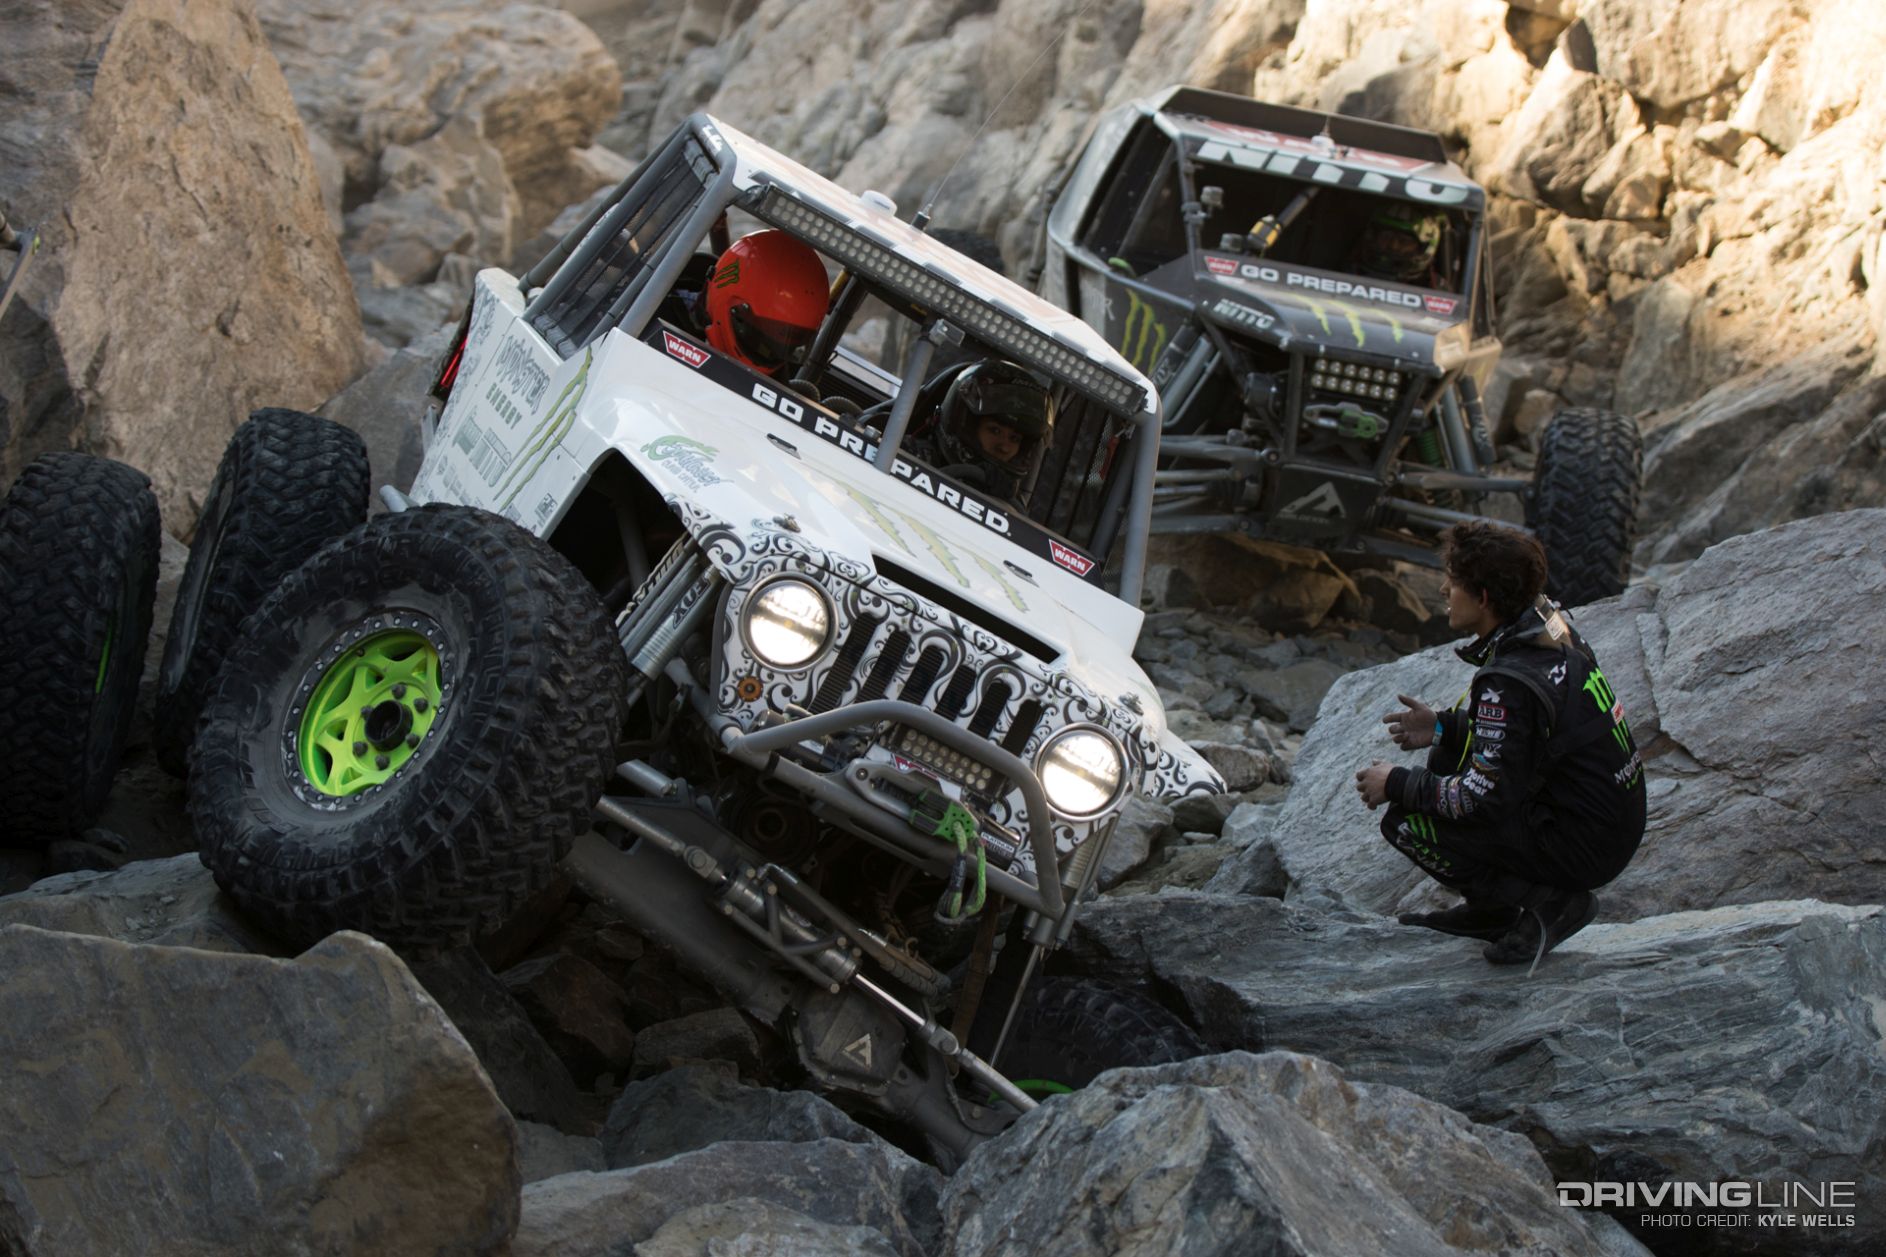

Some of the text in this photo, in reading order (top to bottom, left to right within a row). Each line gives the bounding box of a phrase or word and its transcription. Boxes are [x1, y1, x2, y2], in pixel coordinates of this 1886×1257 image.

[1241, 263, 1421, 308] GO PREPARED
[668, 339, 702, 363] WARN
[751, 382, 804, 423] GO
[1053, 547, 1086, 571] WARN
[672, 577, 711, 630] FOX
[1479, 705, 1503, 719] ARB
